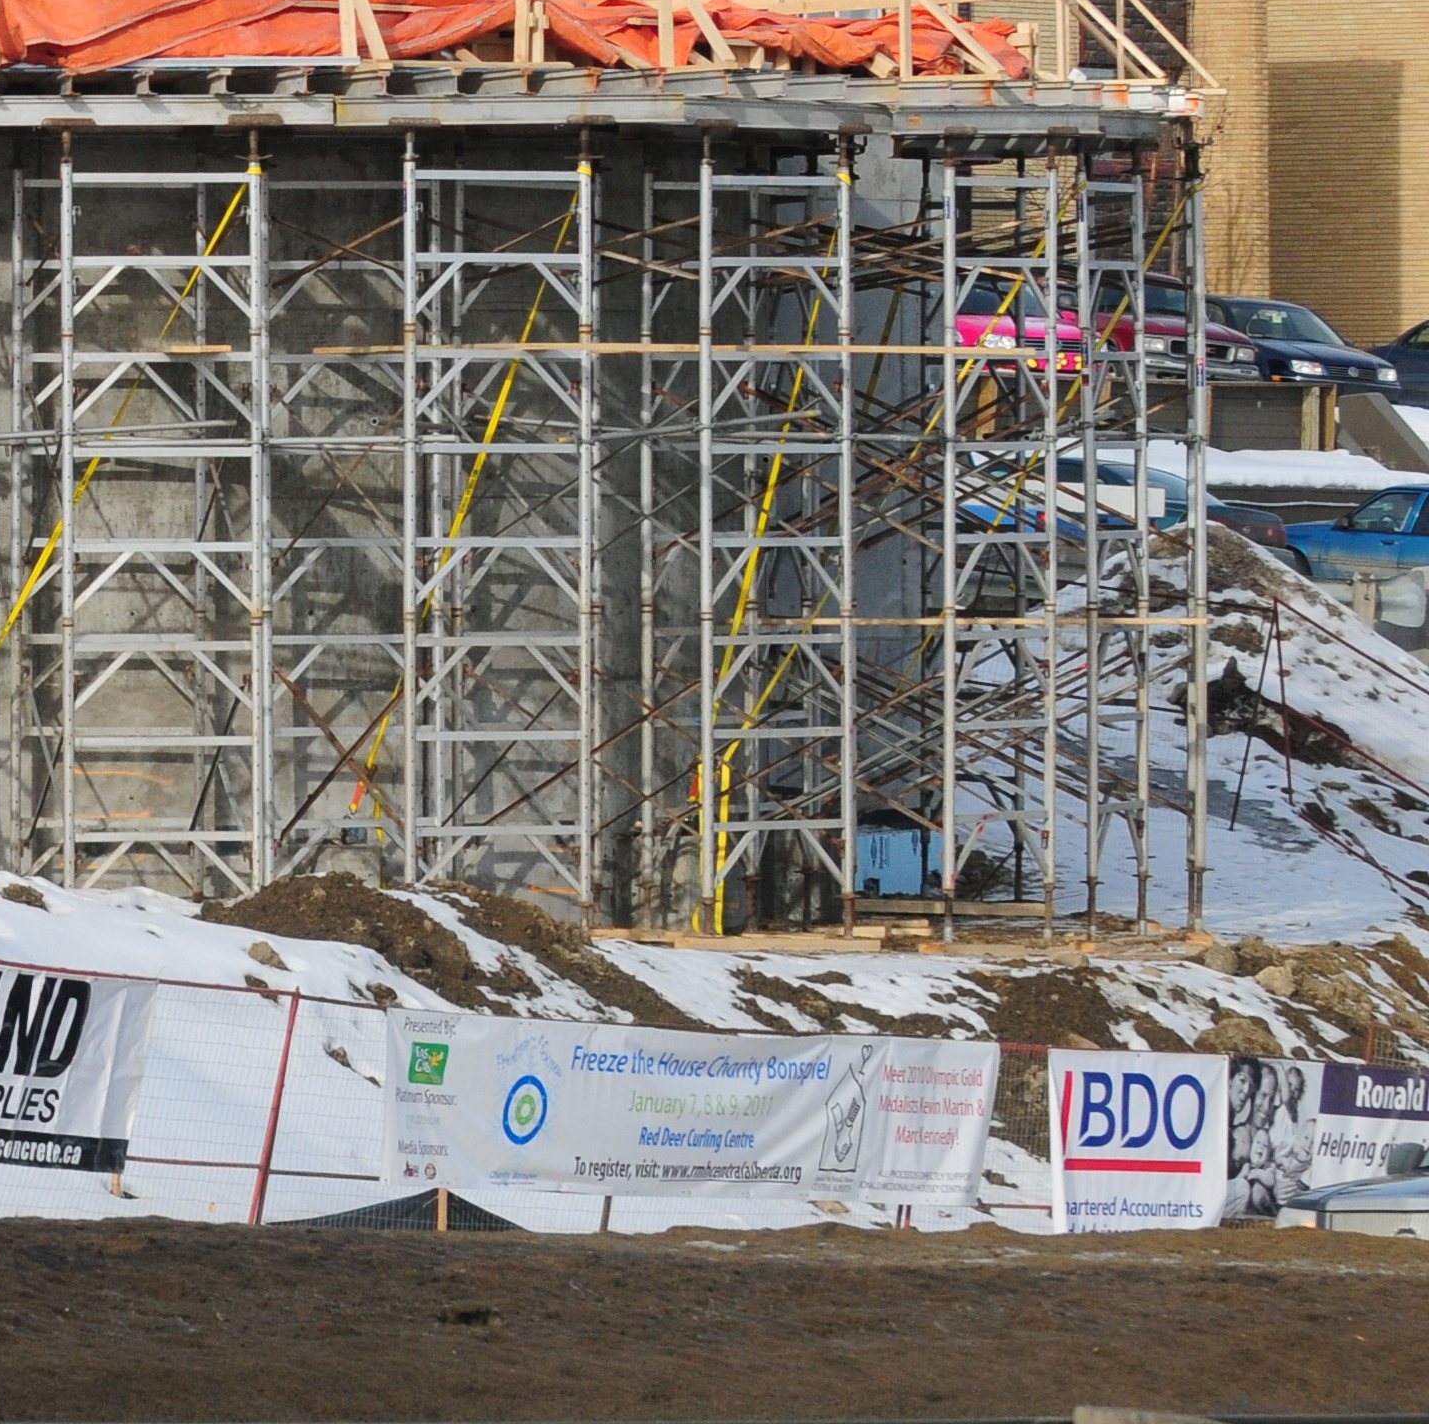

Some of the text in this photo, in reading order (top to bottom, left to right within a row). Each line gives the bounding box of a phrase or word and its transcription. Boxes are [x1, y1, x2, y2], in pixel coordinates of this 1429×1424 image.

[571, 1046, 628, 1073] Freeze
[632, 1048, 655, 1074] the
[657, 1053, 707, 1078] House
[707, 1056, 763, 1085] Charity
[766, 1056, 833, 1086] Bonspiel
[884, 1065, 906, 1083] Meet
[961, 1069, 983, 1087] Gold
[628, 1090, 686, 1119] January
[743, 1095, 774, 1116] 2011
[879, 1094, 919, 1113] Medalists
[943, 1099, 973, 1116] Martin
[977, 1100, 985, 1116] &
[1355, 1074, 1426, 1112] Ronald
[1078, 1071, 1207, 1150] BDO
[638, 1127, 755, 1152] Red Deer Curling Centre
[895, 1125, 918, 1142] Marc
[1317, 1132, 1377, 1168] Helping
[574, 1156, 586, 1175] To
[589, 1158, 631, 1182] register,
[635, 1161, 661, 1178] visit:
[1119, 1198, 1203, 1218] Accountants
